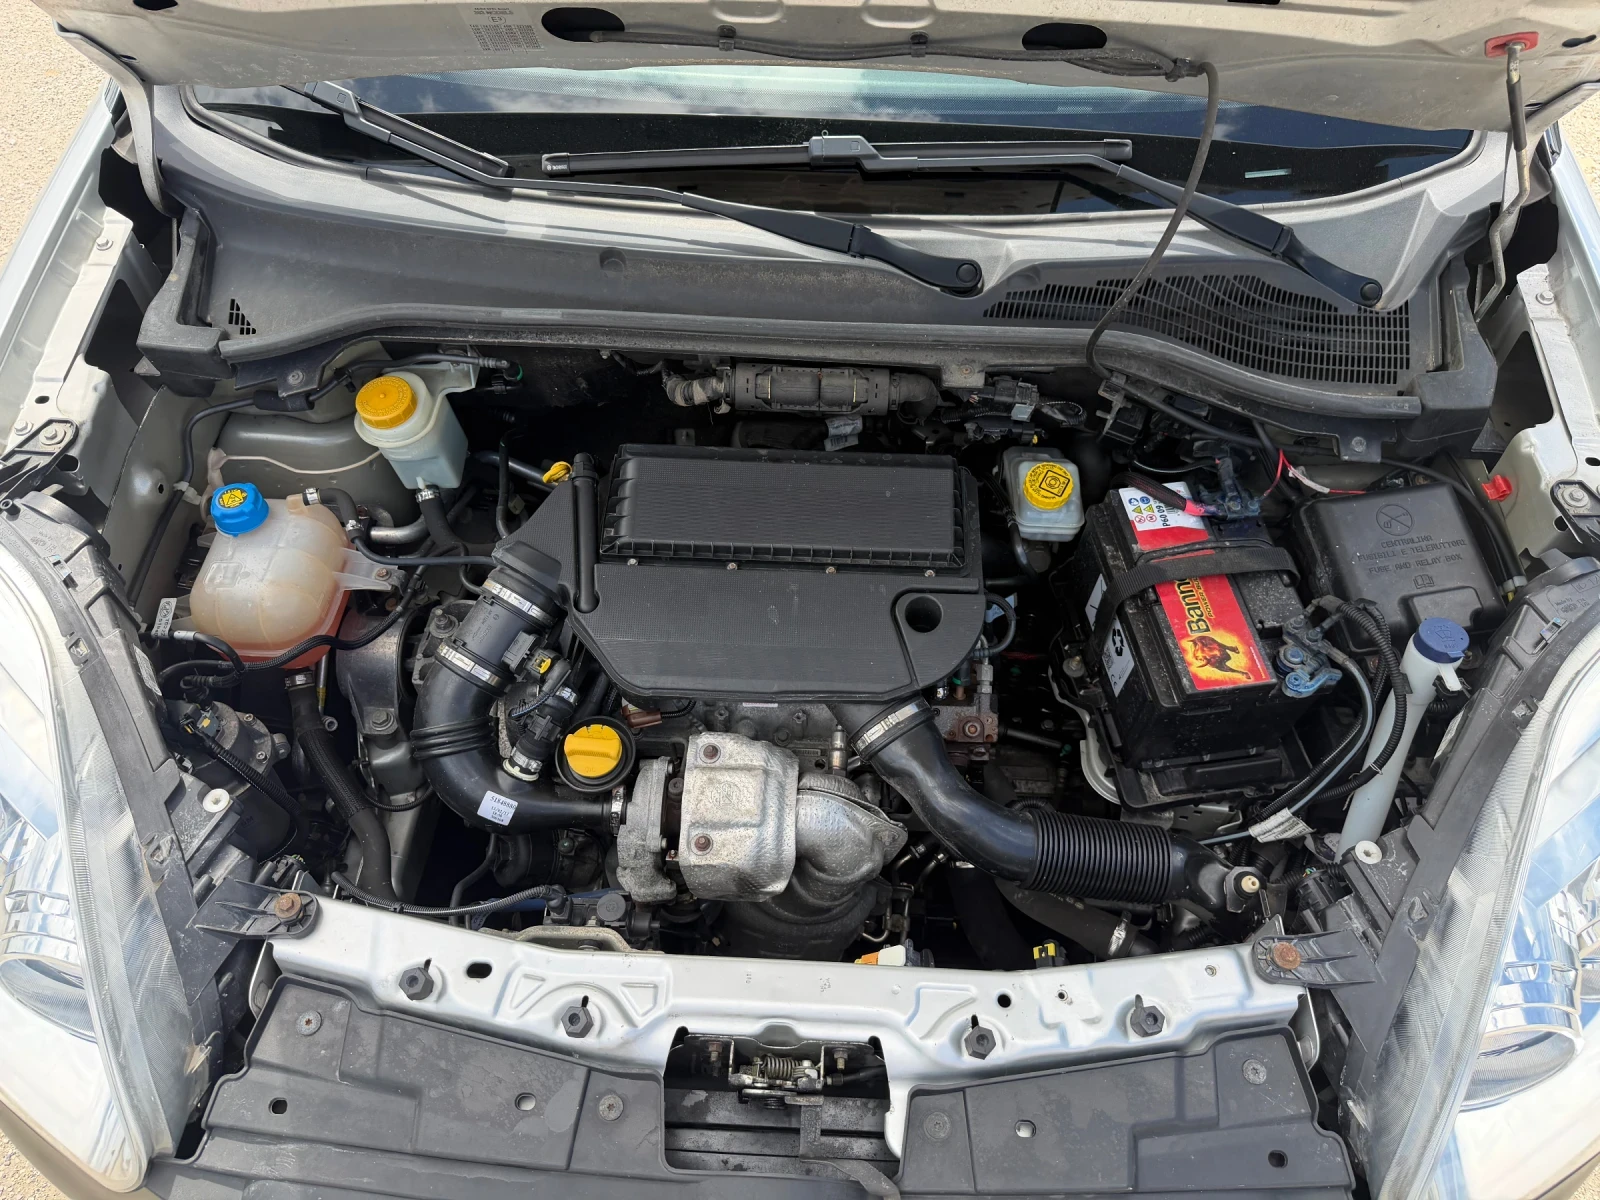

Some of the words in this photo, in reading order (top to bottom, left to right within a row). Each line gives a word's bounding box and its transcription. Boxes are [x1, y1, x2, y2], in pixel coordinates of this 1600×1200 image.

[1159, 514, 1171, 527] P60
[1358, 551, 1397, 562] FUSIBILI
[1400, 548, 1408, 556] E
[1410, 538, 1468, 554] TELERUTTORI
[1380, 534, 1434, 549] CENTRALINA
[1368, 564, 1392, 574] FUSE
[1395, 561, 1412, 571] AND
[1415, 556, 1442, 567] RELAY
[1444, 553, 1463, 563] BOX
[1174, 577, 1211, 635] Bann
[1198, 591, 1215, 618] POWER
